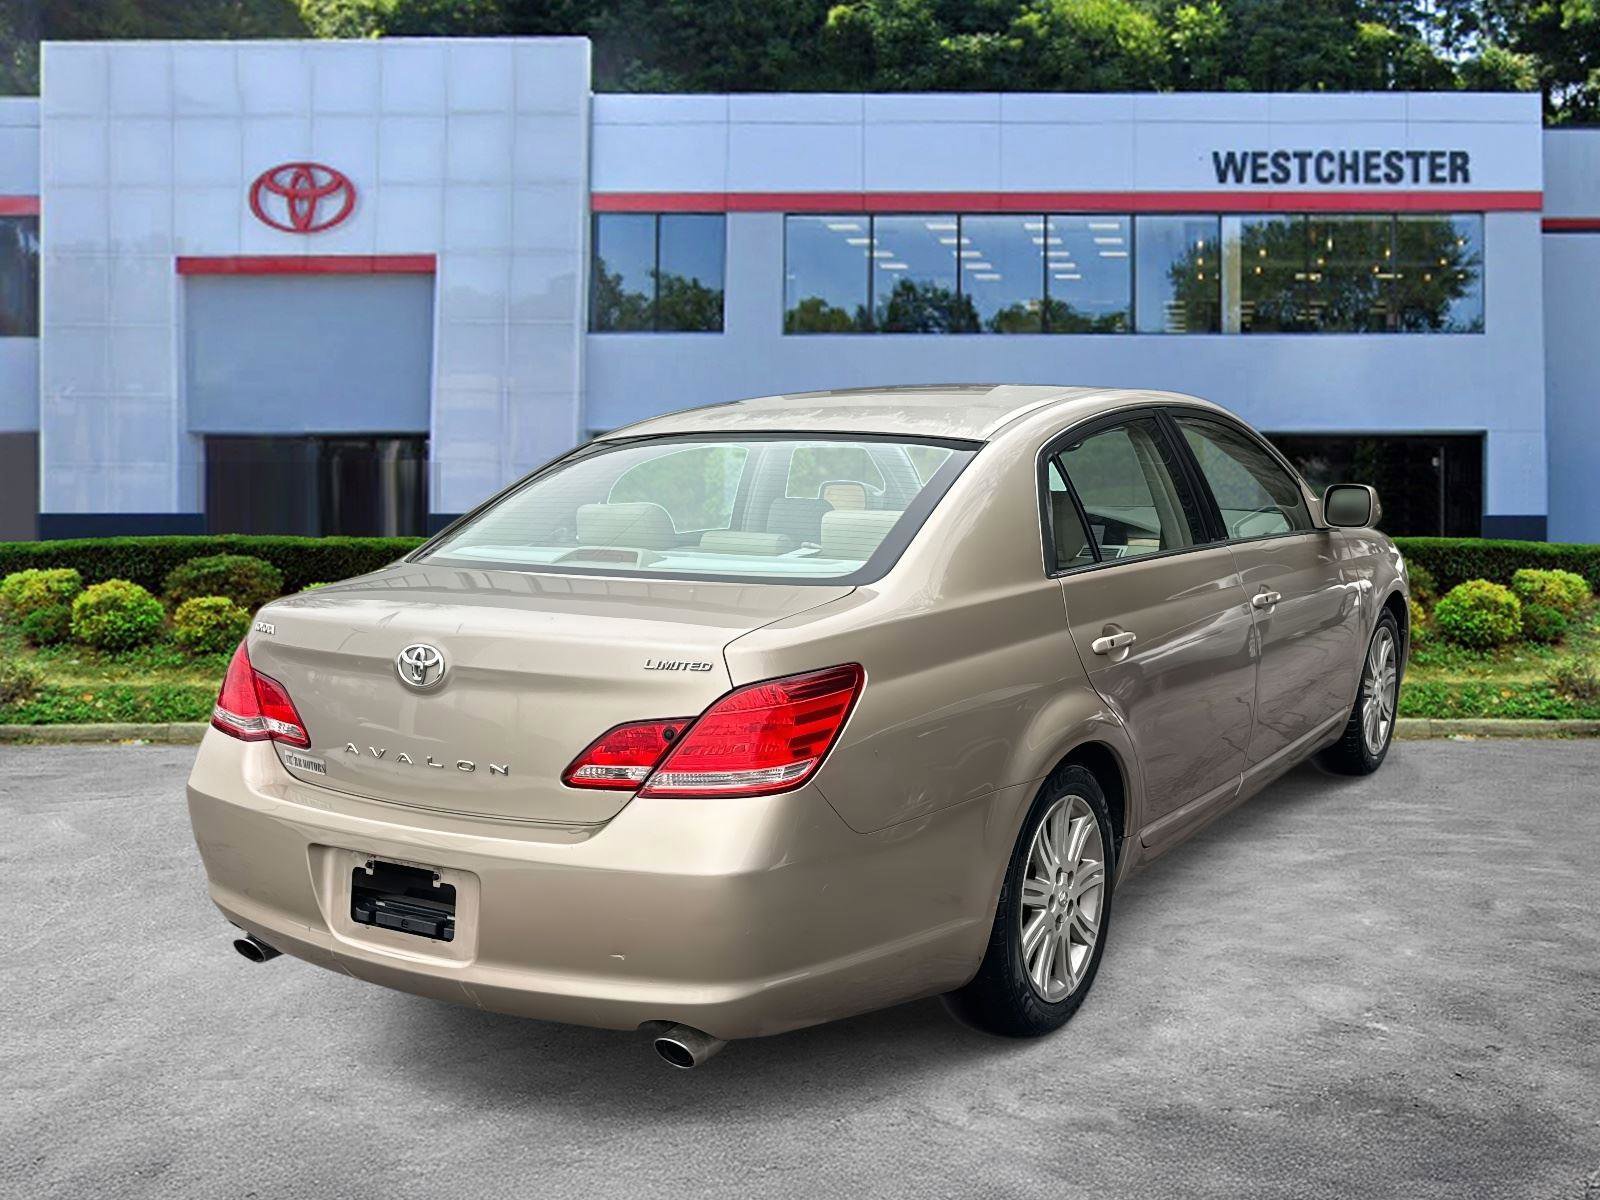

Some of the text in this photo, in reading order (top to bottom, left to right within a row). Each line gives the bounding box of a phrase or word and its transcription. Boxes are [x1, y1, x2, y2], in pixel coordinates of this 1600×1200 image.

[1212, 150, 1471, 184] WESTCHESTER
[643, 659, 714, 672] LIMITED
[344, 742, 509, 777] AVALON
